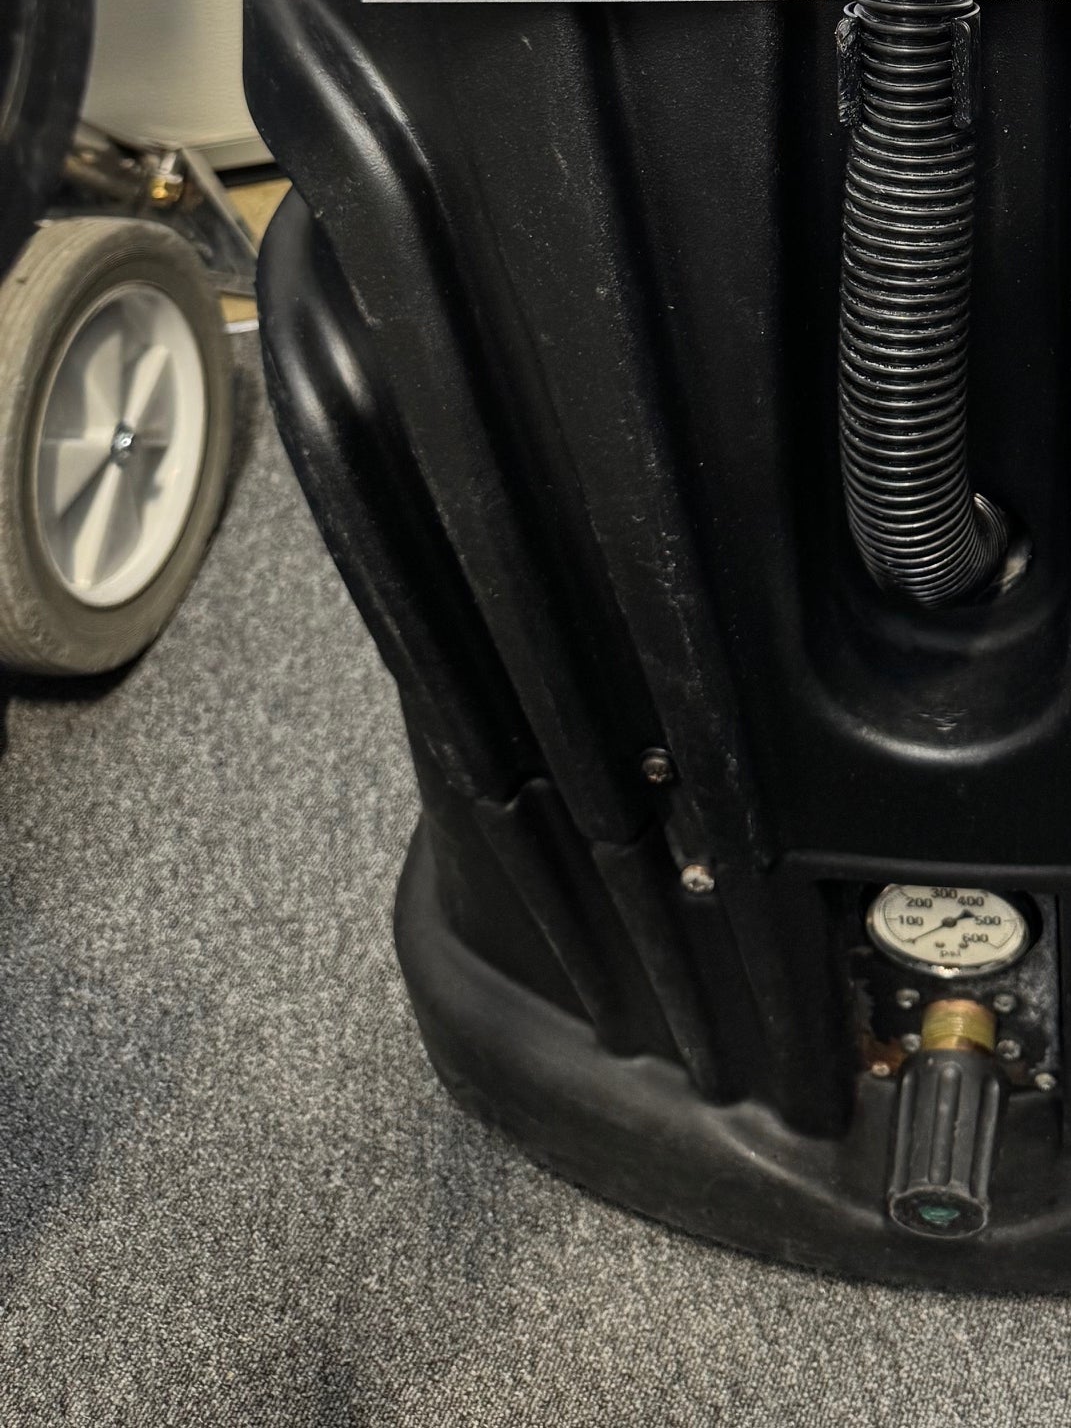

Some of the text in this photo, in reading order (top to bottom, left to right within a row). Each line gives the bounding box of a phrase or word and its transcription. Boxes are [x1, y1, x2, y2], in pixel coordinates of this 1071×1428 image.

[931, 887, 958, 899] 300
[905, 897, 933, 908] 200
[957, 896, 985, 907] 400
[898, 915, 924, 926] 100
[975, 915, 1001, 926] 500
[961, 933, 989, 943] 600
